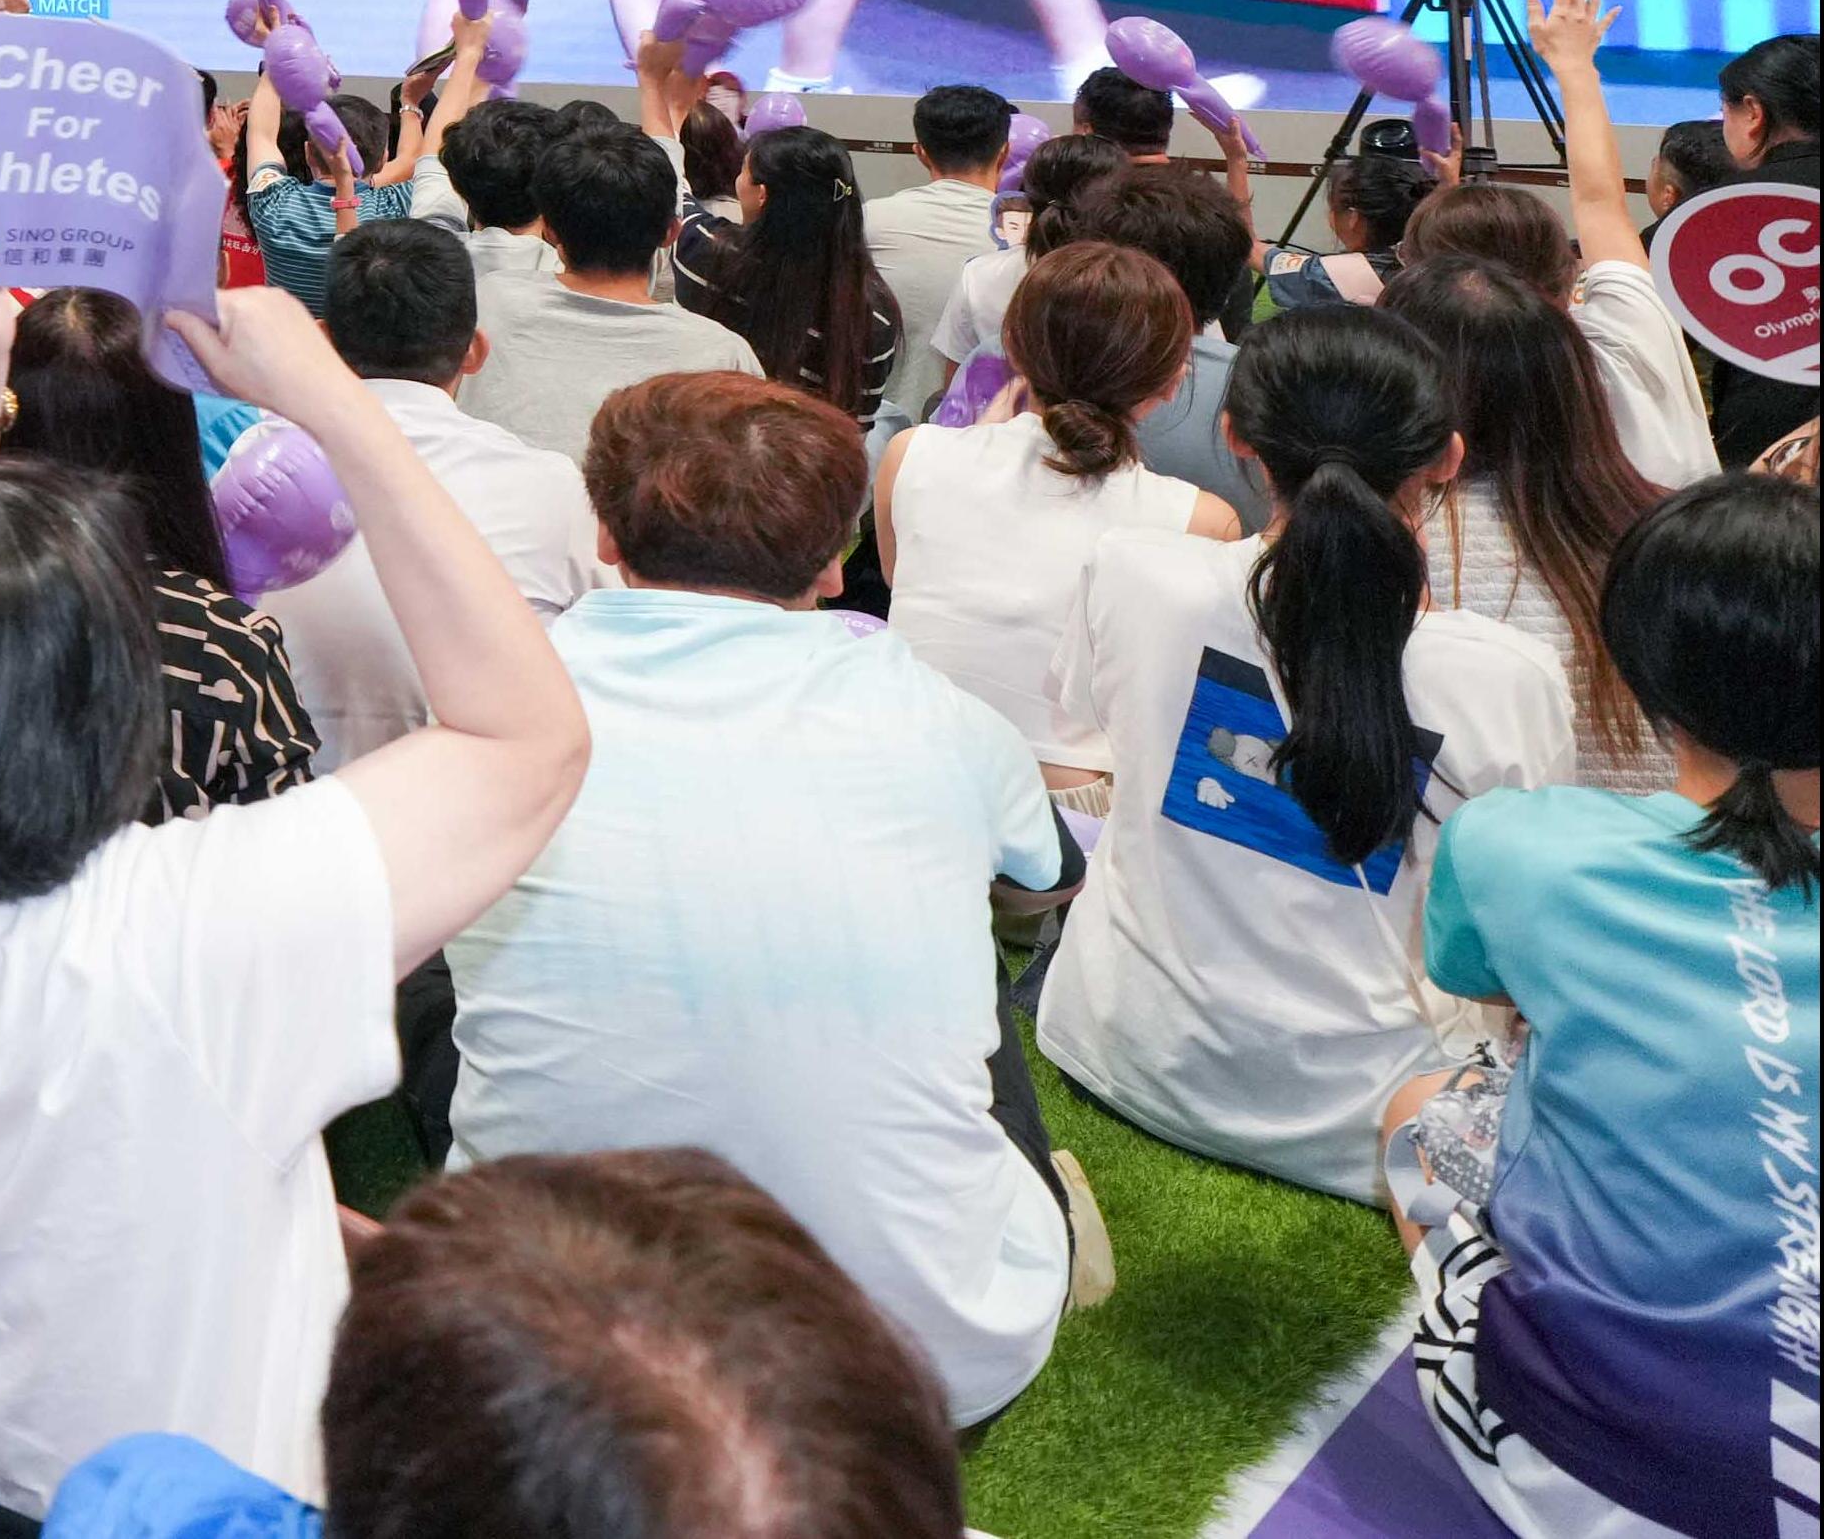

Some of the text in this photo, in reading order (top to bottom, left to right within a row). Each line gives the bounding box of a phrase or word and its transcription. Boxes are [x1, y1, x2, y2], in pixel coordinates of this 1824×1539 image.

[26, 107, 103, 141] For
[3, 247, 109, 268] 信和集團
[5, 227, 136, 253] SINO GROUP
[1709, 218, 1820, 306] OC
[1724, 931, 1791, 1042] LORD
[1743, 1043, 1803, 1097] IS
[1750, 1097, 1816, 1172] MY
[1761, 1158, 1820, 1374] STRENGTH
